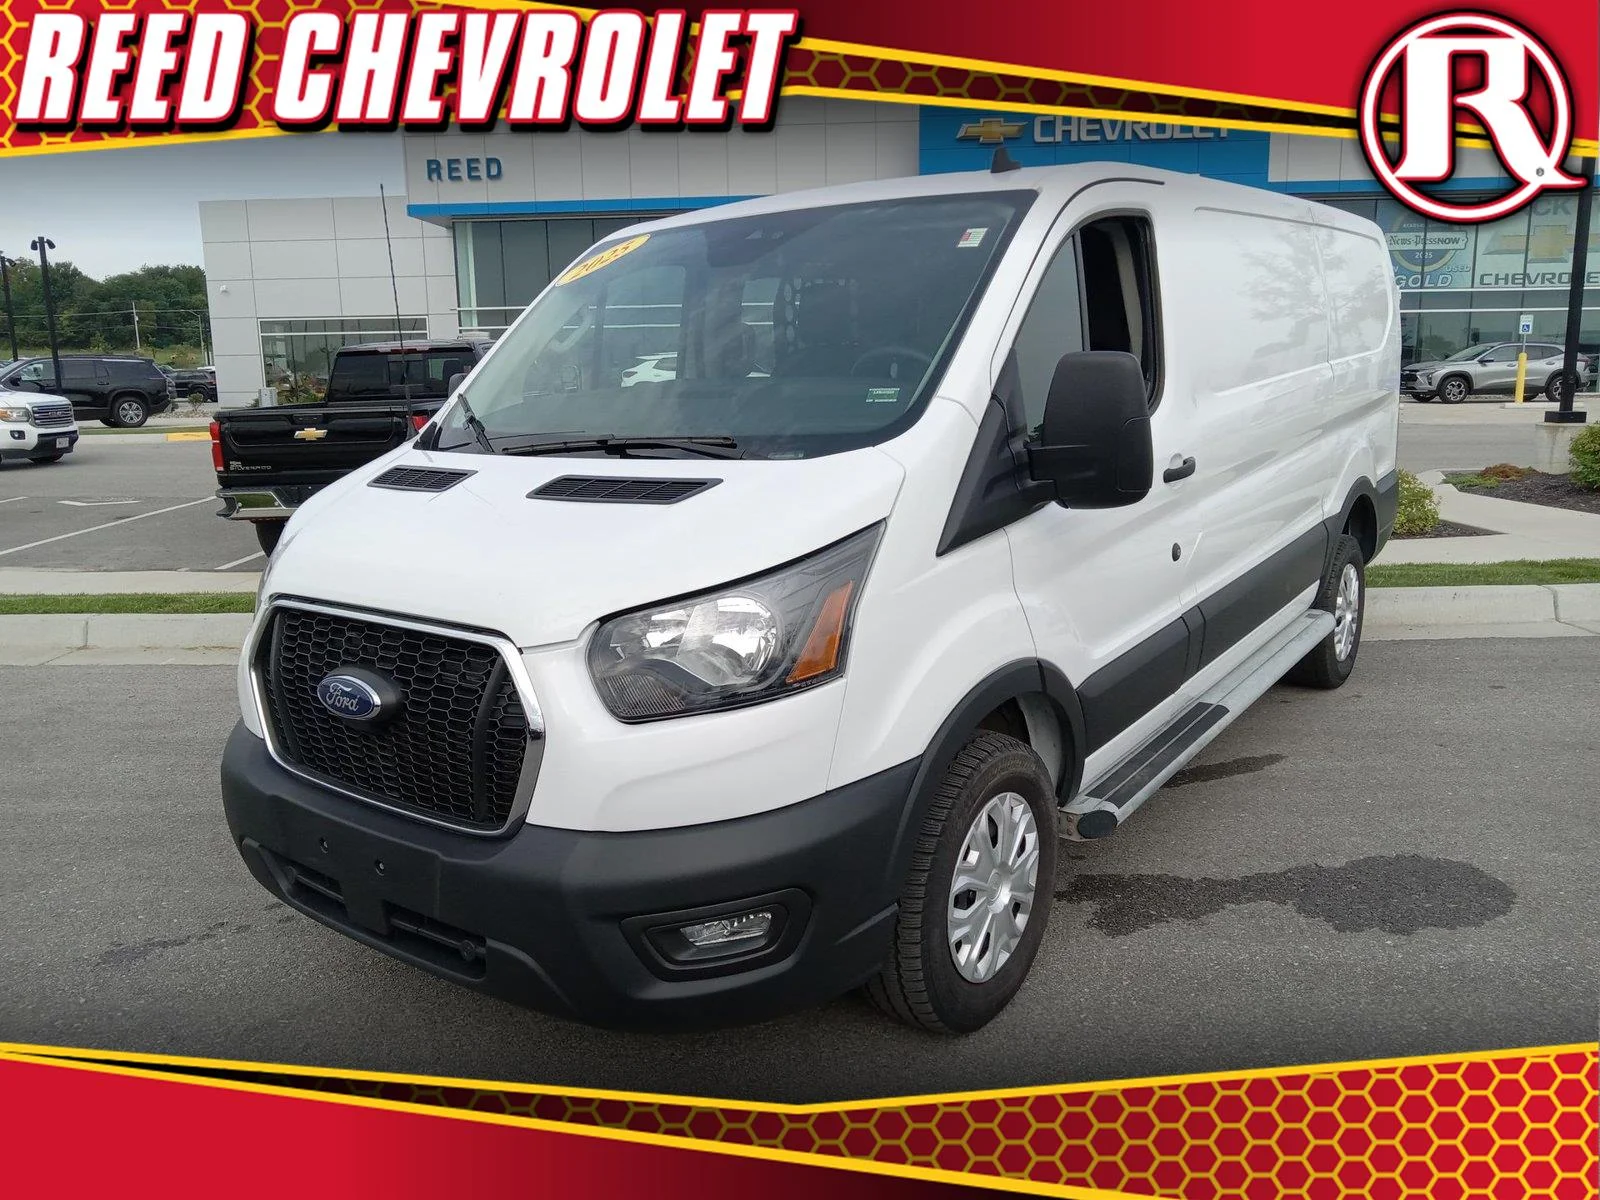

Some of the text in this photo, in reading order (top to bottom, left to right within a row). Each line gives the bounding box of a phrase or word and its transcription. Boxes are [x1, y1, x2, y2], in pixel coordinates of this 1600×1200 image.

[426, 157, 502, 182] REED
[1395, 274, 1453, 288] GOLD
[1479, 271, 1600, 287] CHEVROE
[326, 682, 360, 712] Ford
